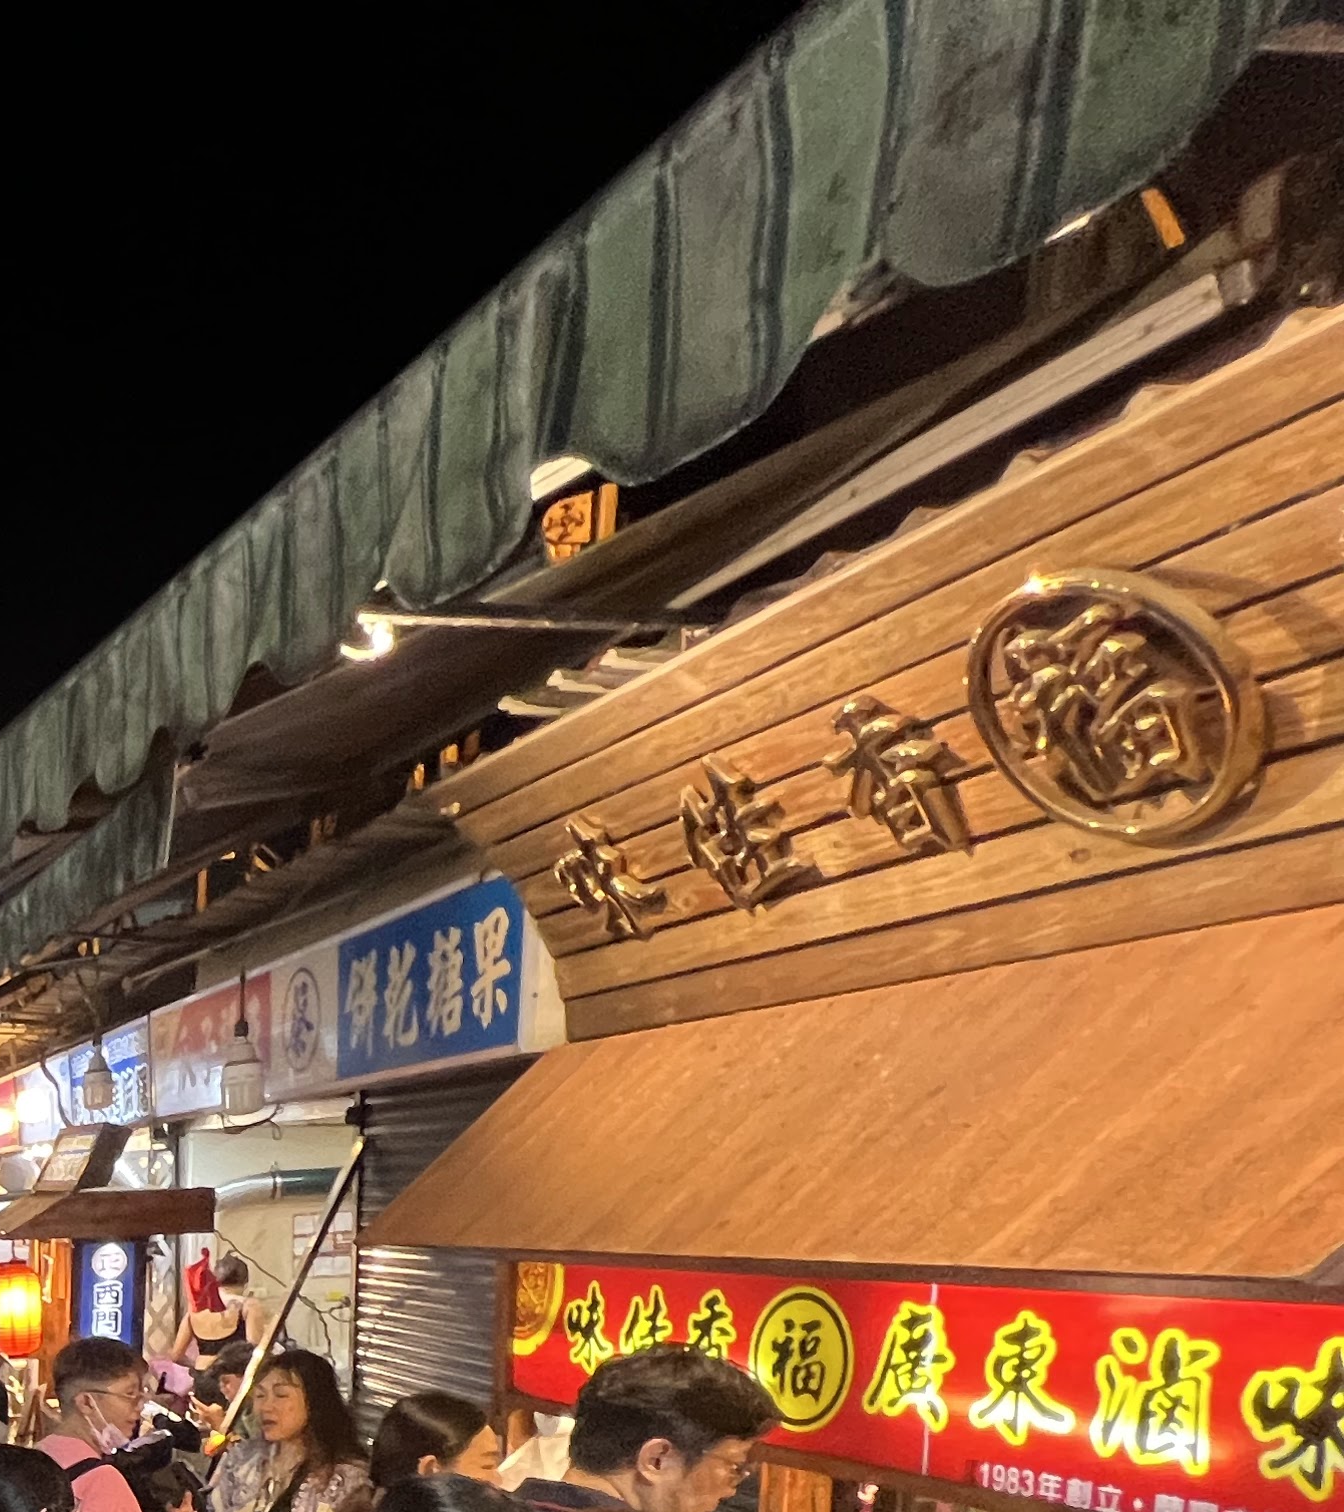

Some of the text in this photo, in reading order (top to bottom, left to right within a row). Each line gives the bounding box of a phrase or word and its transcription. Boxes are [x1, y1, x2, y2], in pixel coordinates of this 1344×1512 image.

[344, 906, 512, 1056] 餅乾糖果
[866, 1304, 1344, 1494] 廣東滷味
